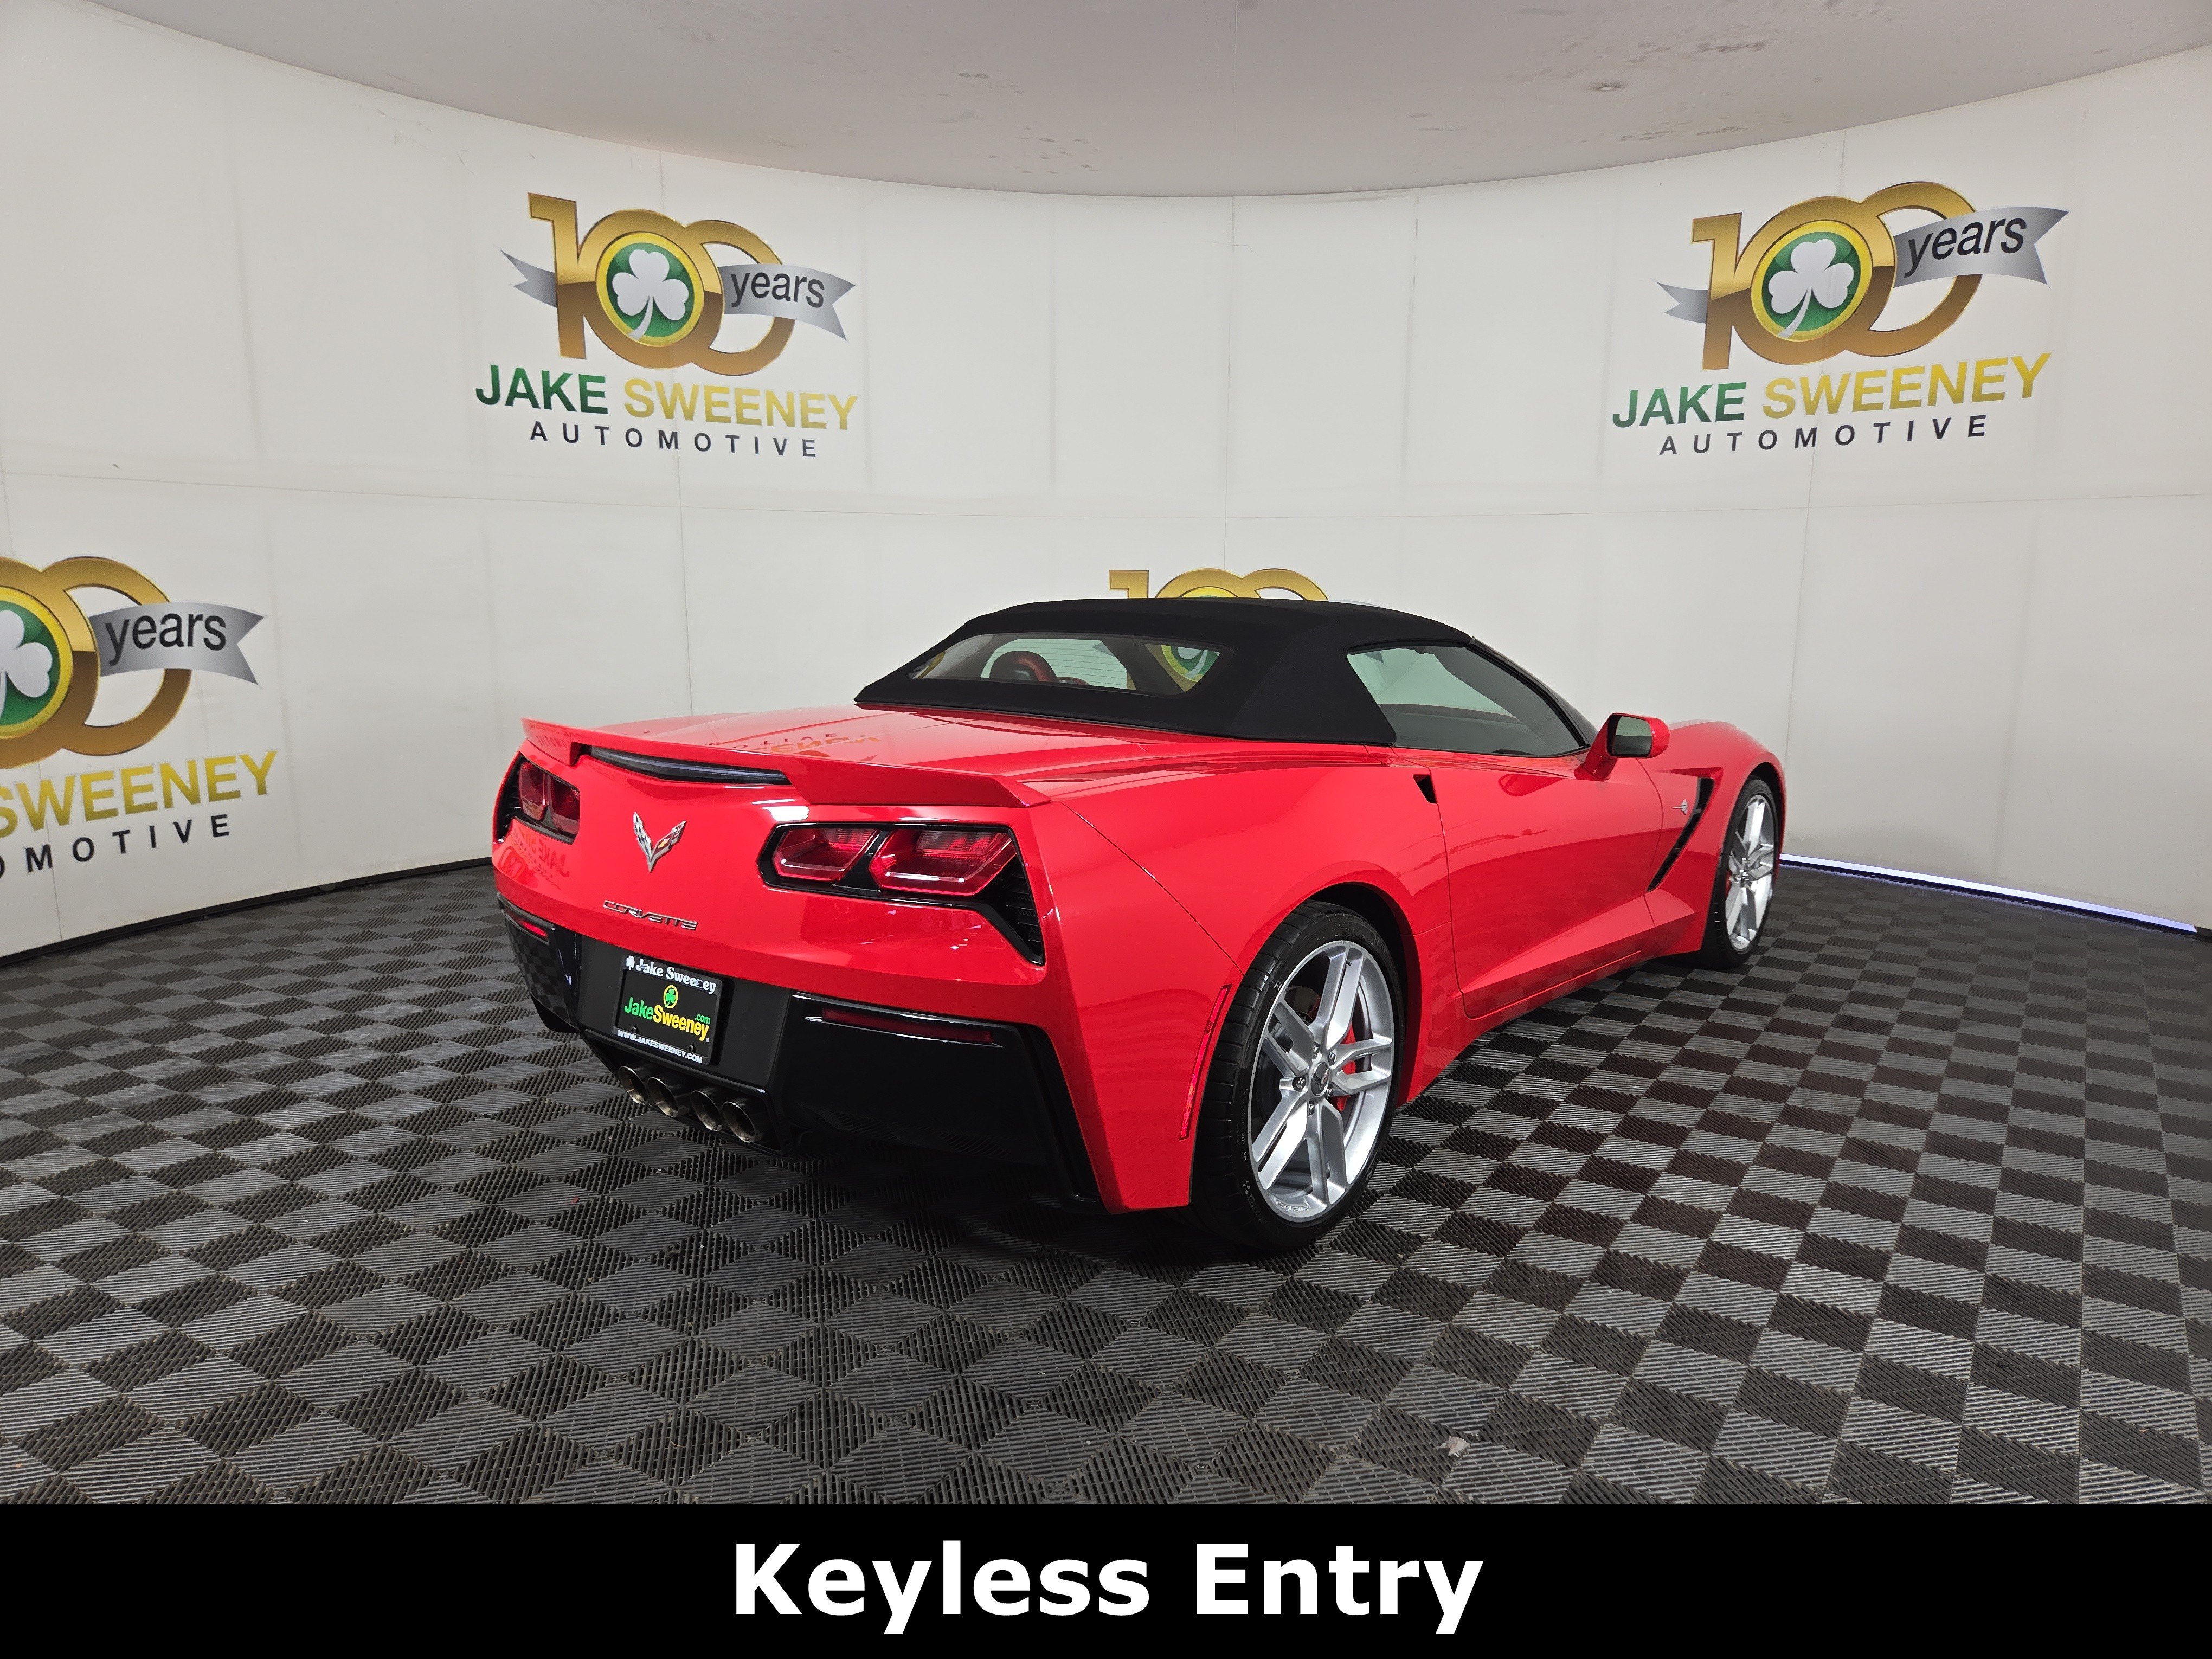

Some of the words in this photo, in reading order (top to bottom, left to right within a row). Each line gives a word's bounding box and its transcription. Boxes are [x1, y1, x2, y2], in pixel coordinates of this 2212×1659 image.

[1903, 217, 2026, 278] years
[731, 271, 825, 308] years
[475, 364, 609, 415] JAKE
[625, 378, 857, 430] SWEENEY
[1612, 382, 1746, 428] JAKE
[1763, 352, 2052, 419] SWEENEY
[530, 421, 816, 458] AUTOMOTIVE
[1660, 415, 1986, 455] AUTOMOTIVE
[105, 613, 227, 666] years
[0, 814, 229, 878] MOTIVE
[603, 899, 698, 930] CORVETTE
[635, 958, 664, 977] Jake
[618, 1030, 703, 1064] WWW.JAKESWEENEY.COM
